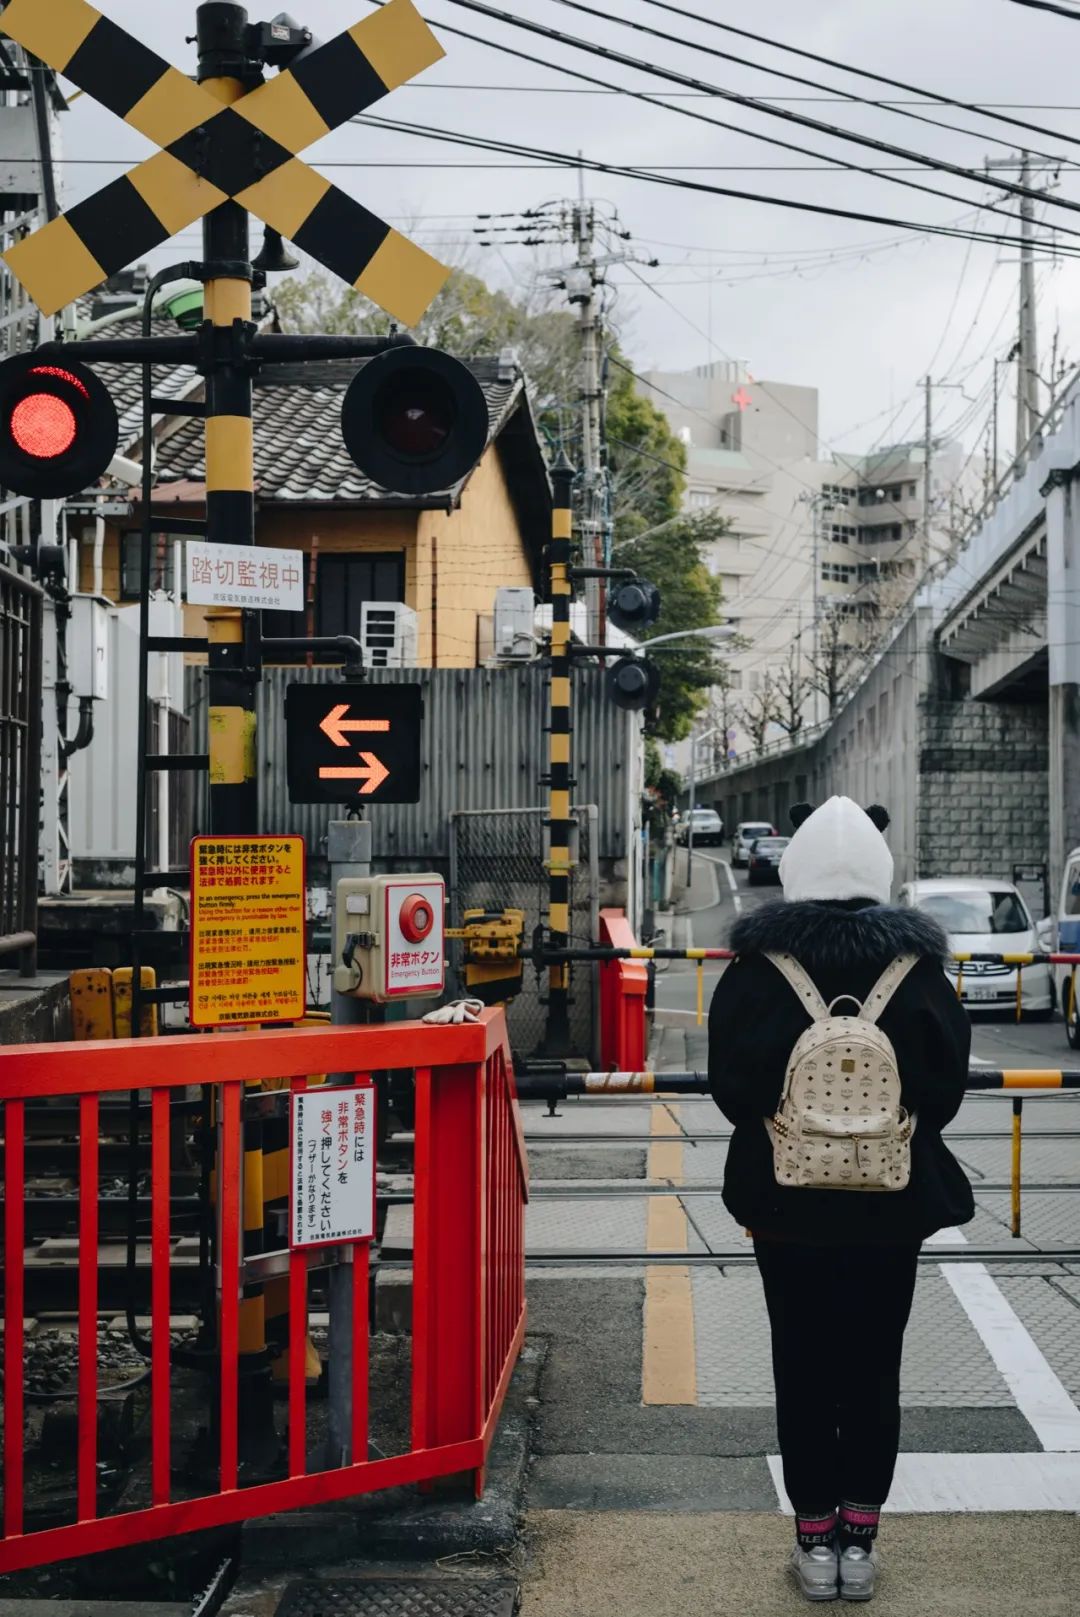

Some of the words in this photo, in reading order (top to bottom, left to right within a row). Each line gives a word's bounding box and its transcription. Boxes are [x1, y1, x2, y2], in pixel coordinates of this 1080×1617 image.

[192, 556, 300, 591] 踏切監視中
[199, 844, 292, 854] 緊急時には非常ボタンを
[199, 855, 280, 865] 強く押してください。
[199, 866, 291, 876] 緊急時以外に使用すると
[391, 950, 440, 967] 非常ボタン
[391, 970, 420, 979] Emergency
[422, 967, 440, 976] Button
[354, 1093, 366, 1162] 緊急時には
[337, 1101, 349, 1184] 非常ボタンを
[320, 1110, 333, 1232] 強く押してください
